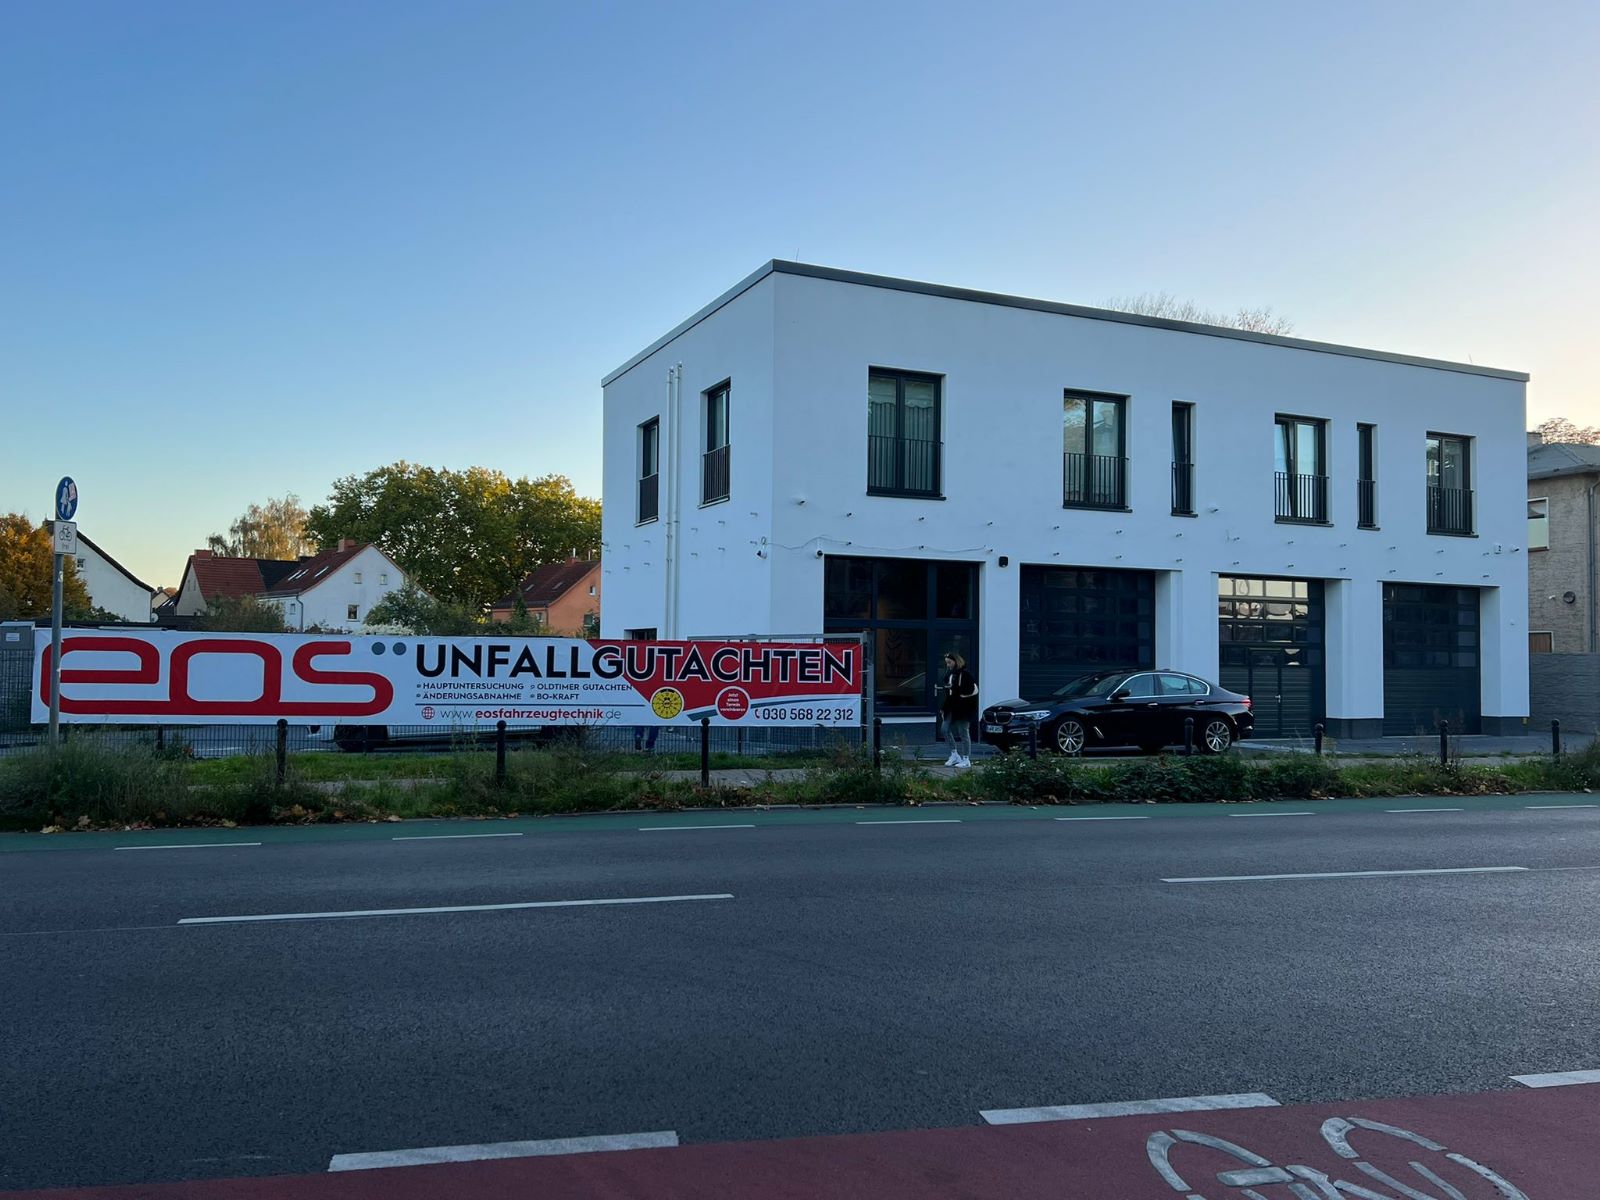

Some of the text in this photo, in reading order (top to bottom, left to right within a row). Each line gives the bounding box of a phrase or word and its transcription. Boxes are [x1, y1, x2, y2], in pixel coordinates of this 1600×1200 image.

[416, 643, 853, 686] UNFALLGUTACHTEN
[40, 636, 394, 716] eos
[423, 682, 524, 690] HAUPTUNTERSUCHUNG
[537, 683, 580, 691] OLDTIMER
[422, 692, 522, 700] ÄNDERUNGSABNAHME
[440, 708, 622, 720] www.eosfahrzeugtechnik.de
[763, 709, 853, 720] 030 568 22 312
